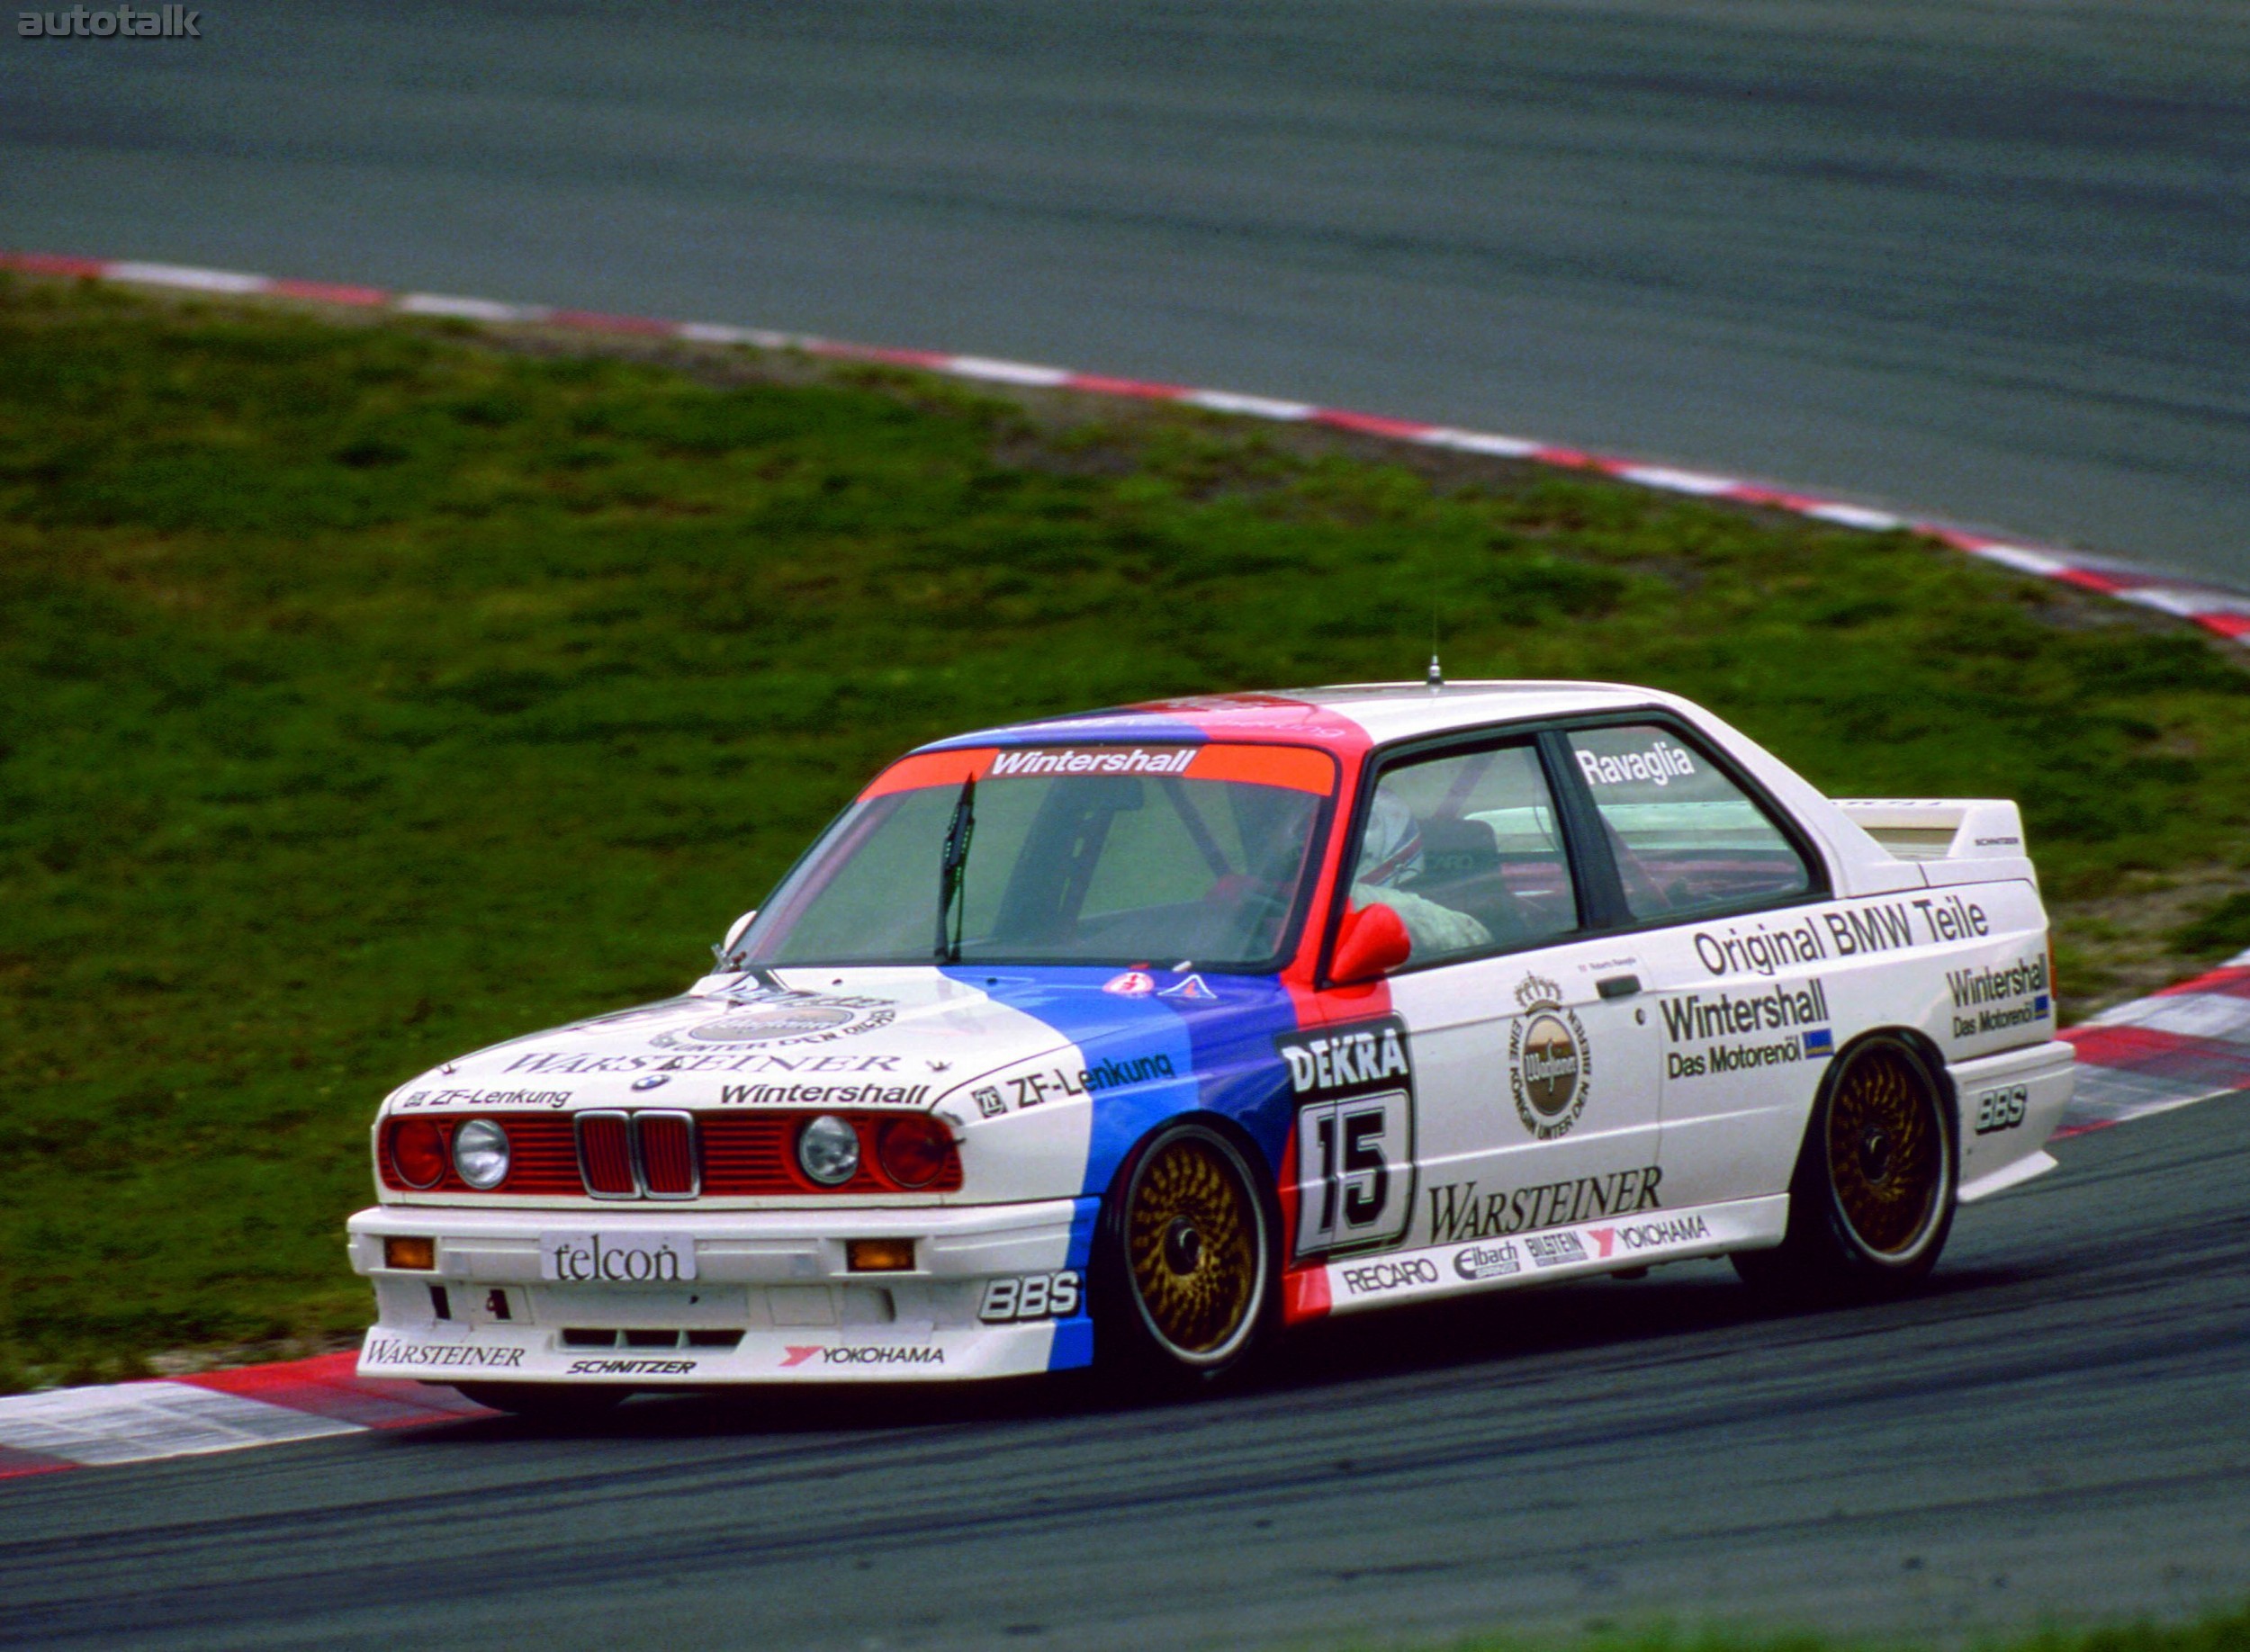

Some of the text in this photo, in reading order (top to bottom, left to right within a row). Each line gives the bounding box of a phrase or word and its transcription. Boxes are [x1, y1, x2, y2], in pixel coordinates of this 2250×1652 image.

[992, 749, 1197, 776] Wintershall
[1576, 747, 1696, 787] Ravaglia
[1694, 894, 1989, 976] Original BMW Teile
[1946, 953, 2048, 1008] Wintershall
[1660, 979, 1830, 1042] Wintershall
[1952, 1001, 2033, 1038] Das Motorenöl
[502, 1051, 903, 1074] WARSTEINER
[1282, 1028, 1408, 1092] DEKRA
[1667, 1036, 1803, 1079] Das Motorenöl
[429, 1089, 573, 1109] ZF-Lenkung
[721, 1083, 932, 1106] Wintershall
[1975, 1083, 2027, 1134] BBS
[1318, 1108, 1387, 1233] 15
[1427, 1166, 1662, 1243] WARSTEINER
[1525, 1231, 1585, 1265] BILSTEIN
[1616, 1215, 1710, 1249] YOKOHAMA
[554, 1235, 680, 1281] telcon
[1343, 1258, 1439, 1294] RECARO
[979, 1270, 1080, 1321] BBS
[364, 1340, 526, 1368] WARSTEINER
[567, 1359, 698, 1374] SCHNITZER
[823, 1346, 945, 1365] YOKOHAMA
